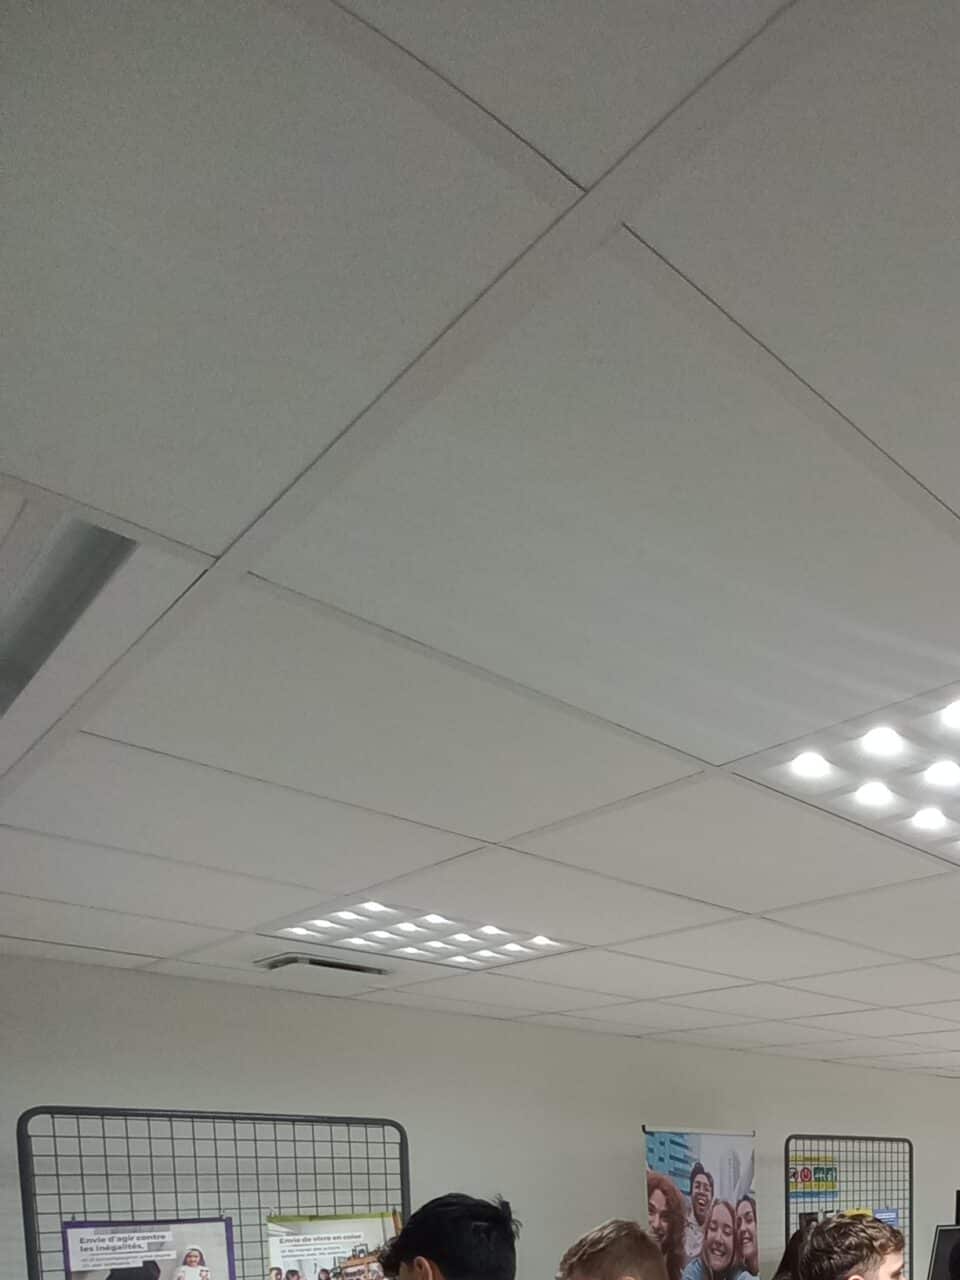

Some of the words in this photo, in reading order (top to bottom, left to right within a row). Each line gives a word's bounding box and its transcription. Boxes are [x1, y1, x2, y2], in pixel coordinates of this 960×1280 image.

[80, 1235, 106, 1244] Envie
[108, 1234, 134, 1243] d'agir
[136, 1234, 166, 1242] contre
[80, 1244, 93, 1252] les
